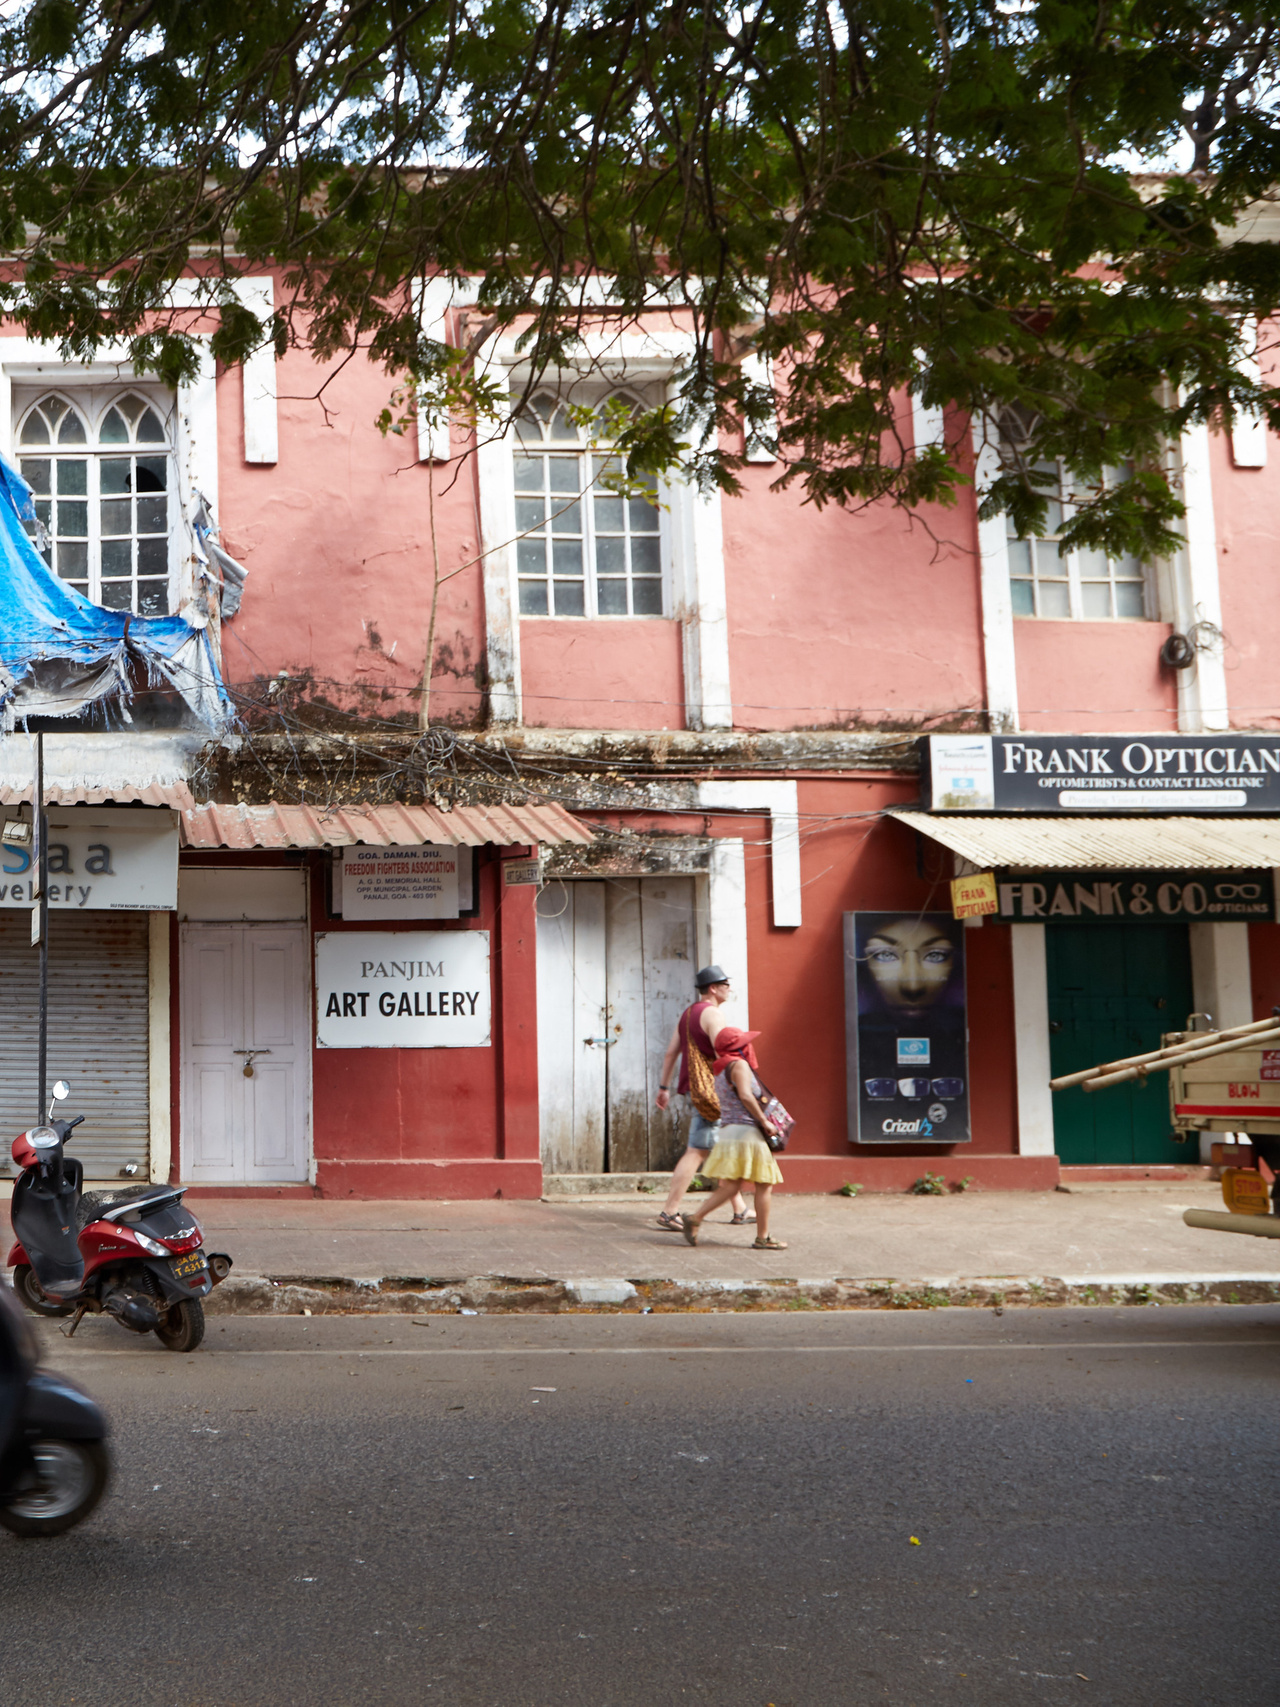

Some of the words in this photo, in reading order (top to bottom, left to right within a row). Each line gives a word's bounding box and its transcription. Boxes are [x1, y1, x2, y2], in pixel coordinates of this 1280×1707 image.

[1001, 743, 1114, 774] FRANK
[1127, 778, 1136, 788] &
[1138, 777, 1194, 788] CONTACT
[1195, 777, 1225, 788] LENS
[1224, 777, 1264, 788] CLINIC
[2, 842, 115, 876] Saa
[357, 852, 381, 860] GOA.
[383, 851, 420, 859] DAMAN.
[422, 850, 442, 858] DIU.
[344, 863, 376, 876] FREEDOM
[377, 862, 410, 875] FIGHTERS
[411, 861, 456, 875] ASSOCIATION
[374, 885, 411, 893] MUNICIPAL
[961, 887, 987, 901] FRANK
[999, 882, 1125, 917] FRANK
[1129, 882, 1154, 916] &
[1156, 882, 1208, 915] CO
[956, 900, 997, 918] OPTICIANS
[1207, 902, 1269, 914] OPTICIANS
[360, 960, 445, 981] PANJIM
[325, 992, 370, 1017] ART
[378, 991, 480, 1017] GALLERY
[1228, 1082, 1260, 1098] BLOW
[882, 1118, 921, 1133] Crizal
[1235, 1179, 1262, 1194] STOP
[174, 1268, 183, 1277] T
[184, 1260, 207, 1273] 4313
